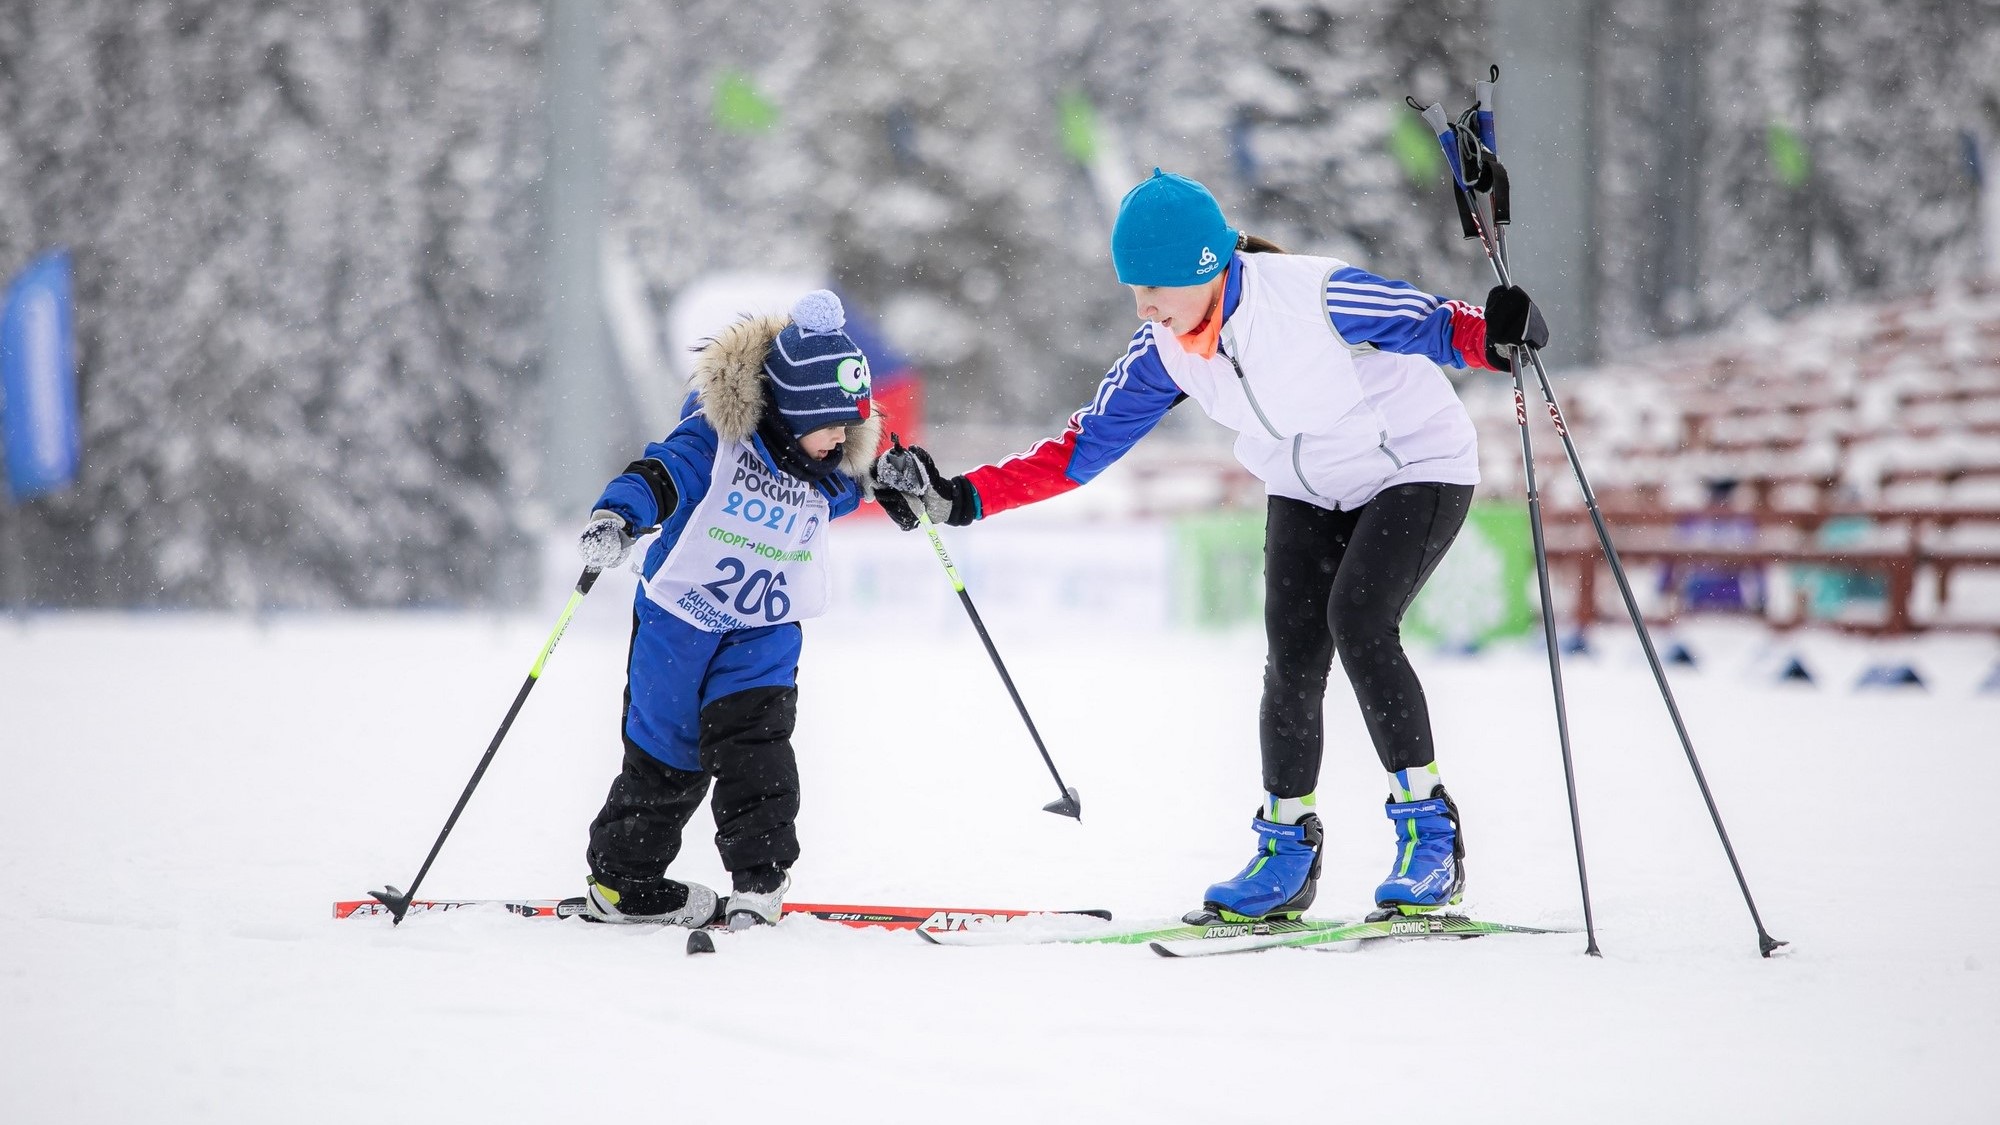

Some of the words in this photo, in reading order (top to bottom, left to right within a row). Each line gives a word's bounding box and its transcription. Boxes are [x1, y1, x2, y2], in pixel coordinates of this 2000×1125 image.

[1197, 263, 1219, 275] odlo
[731, 466, 806, 509] РОССИИ
[721, 490, 797, 534] 2021
[708, 526, 750, 549] СПОРТ
[701, 556, 791, 623] 206
[1391, 804, 1436, 814] SPINE
[1256, 824, 1296, 836] SPINE
[1410, 852, 1454, 898] SPINE
[1203, 926, 1249, 939] ATOMIC
[1390, 921, 1427, 934] ATOMIC
